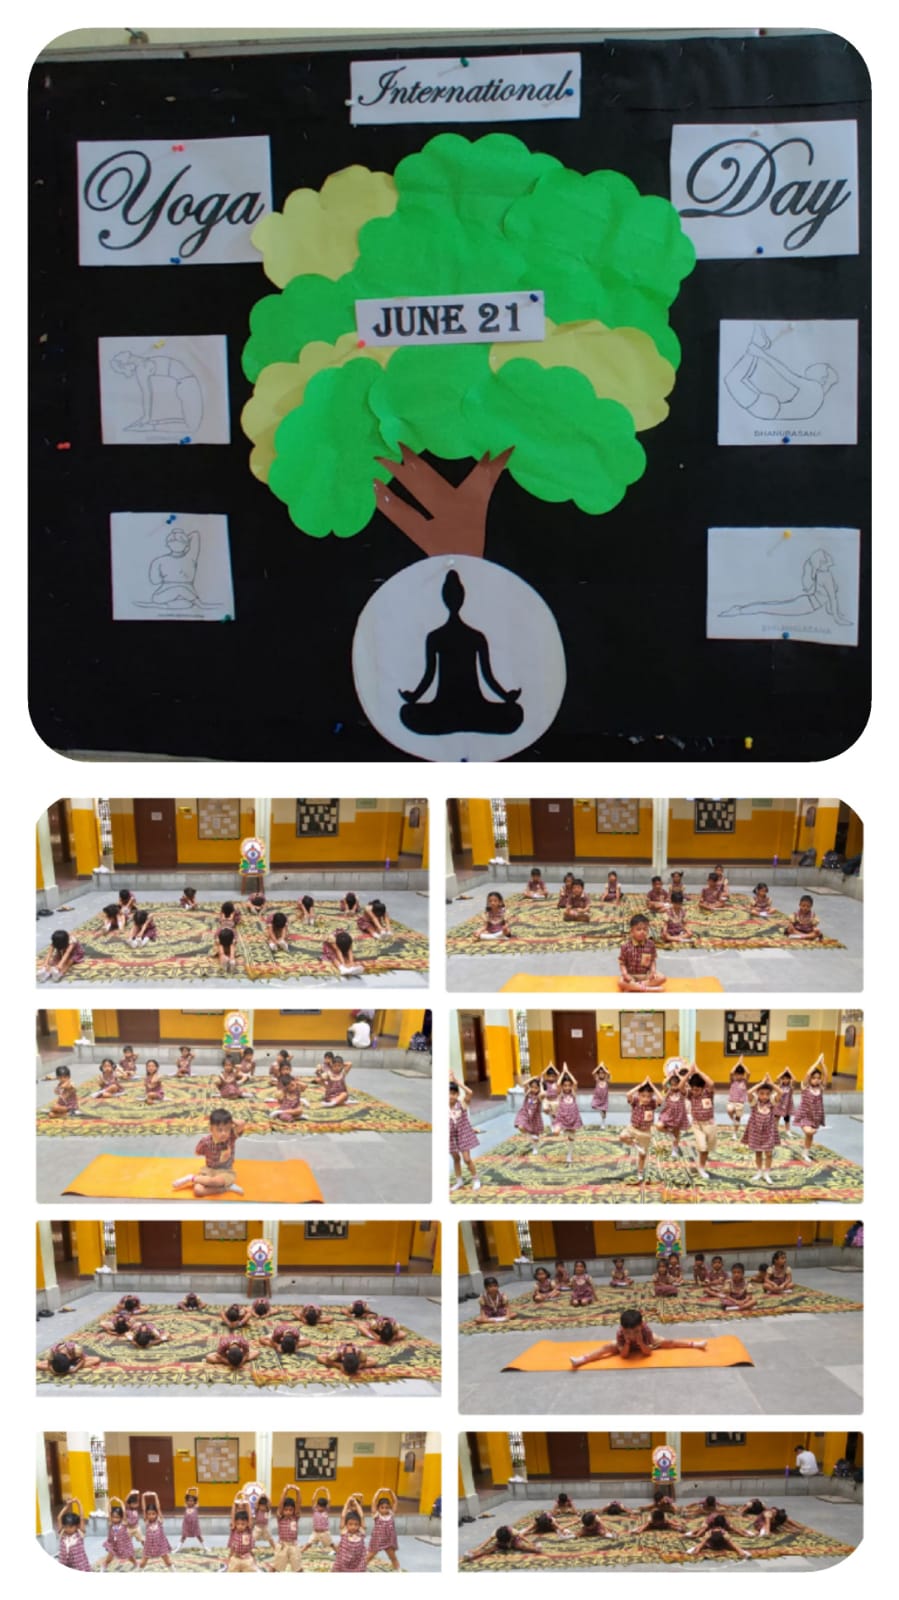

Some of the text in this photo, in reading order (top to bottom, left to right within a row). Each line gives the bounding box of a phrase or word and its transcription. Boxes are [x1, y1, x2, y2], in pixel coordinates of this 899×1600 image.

[358, 66, 573, 106] International
[84, 150, 265, 258] Yoga
[678, 137, 851, 251] Day
[372, 302, 520, 338] JUNE 21
